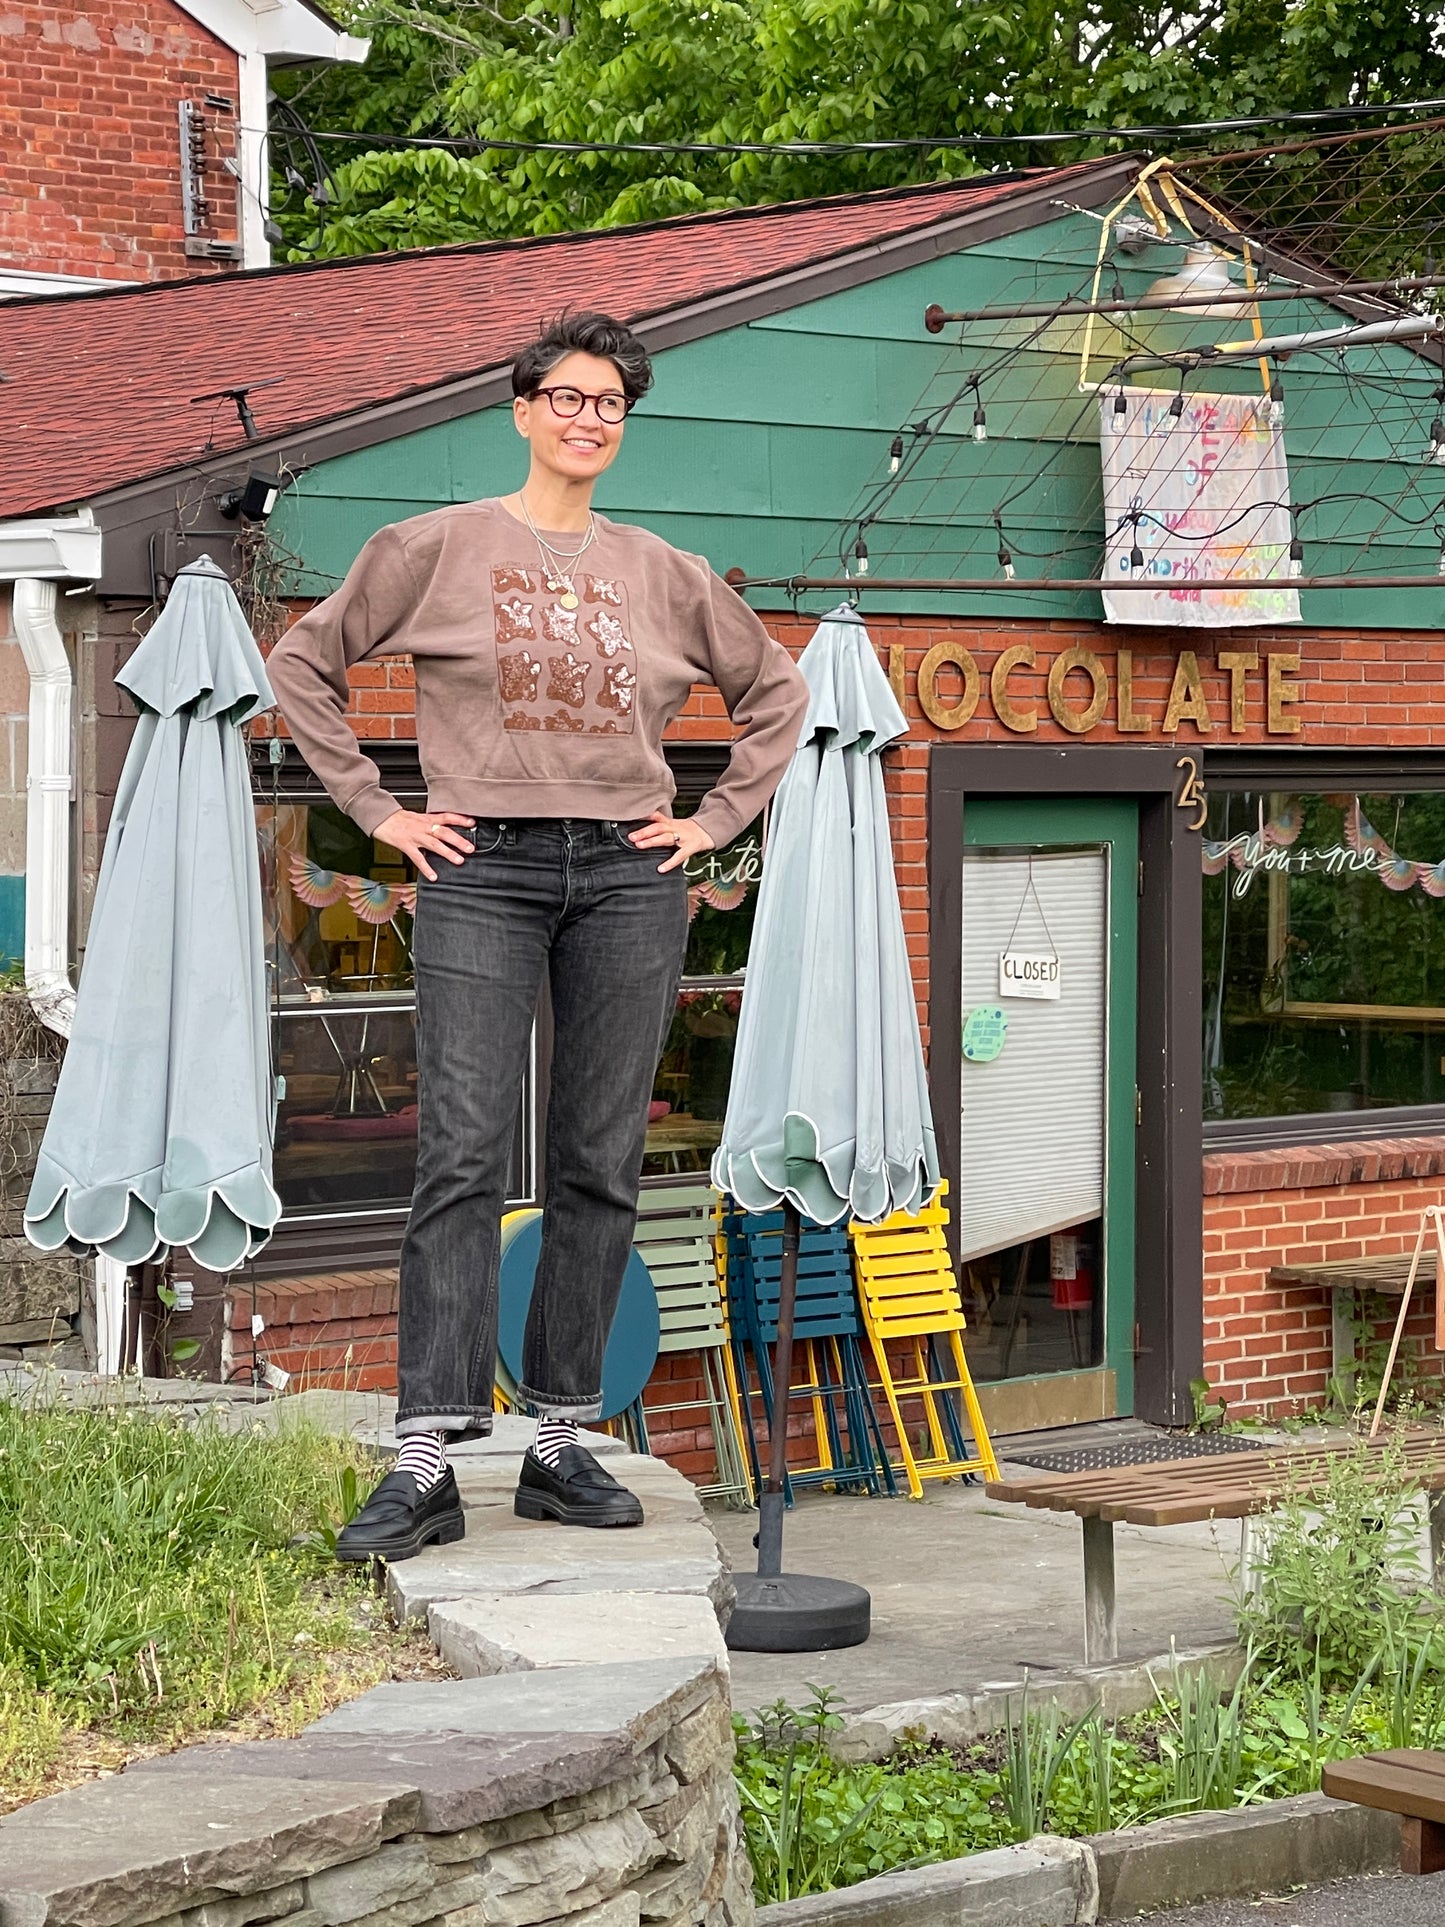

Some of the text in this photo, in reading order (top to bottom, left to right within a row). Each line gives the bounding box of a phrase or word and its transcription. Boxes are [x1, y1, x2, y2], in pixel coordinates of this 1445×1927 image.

[1176, 756, 1208, 831] 25
[719, 839, 763, 883] te
[1004, 960, 1058, 981] CLOSED
